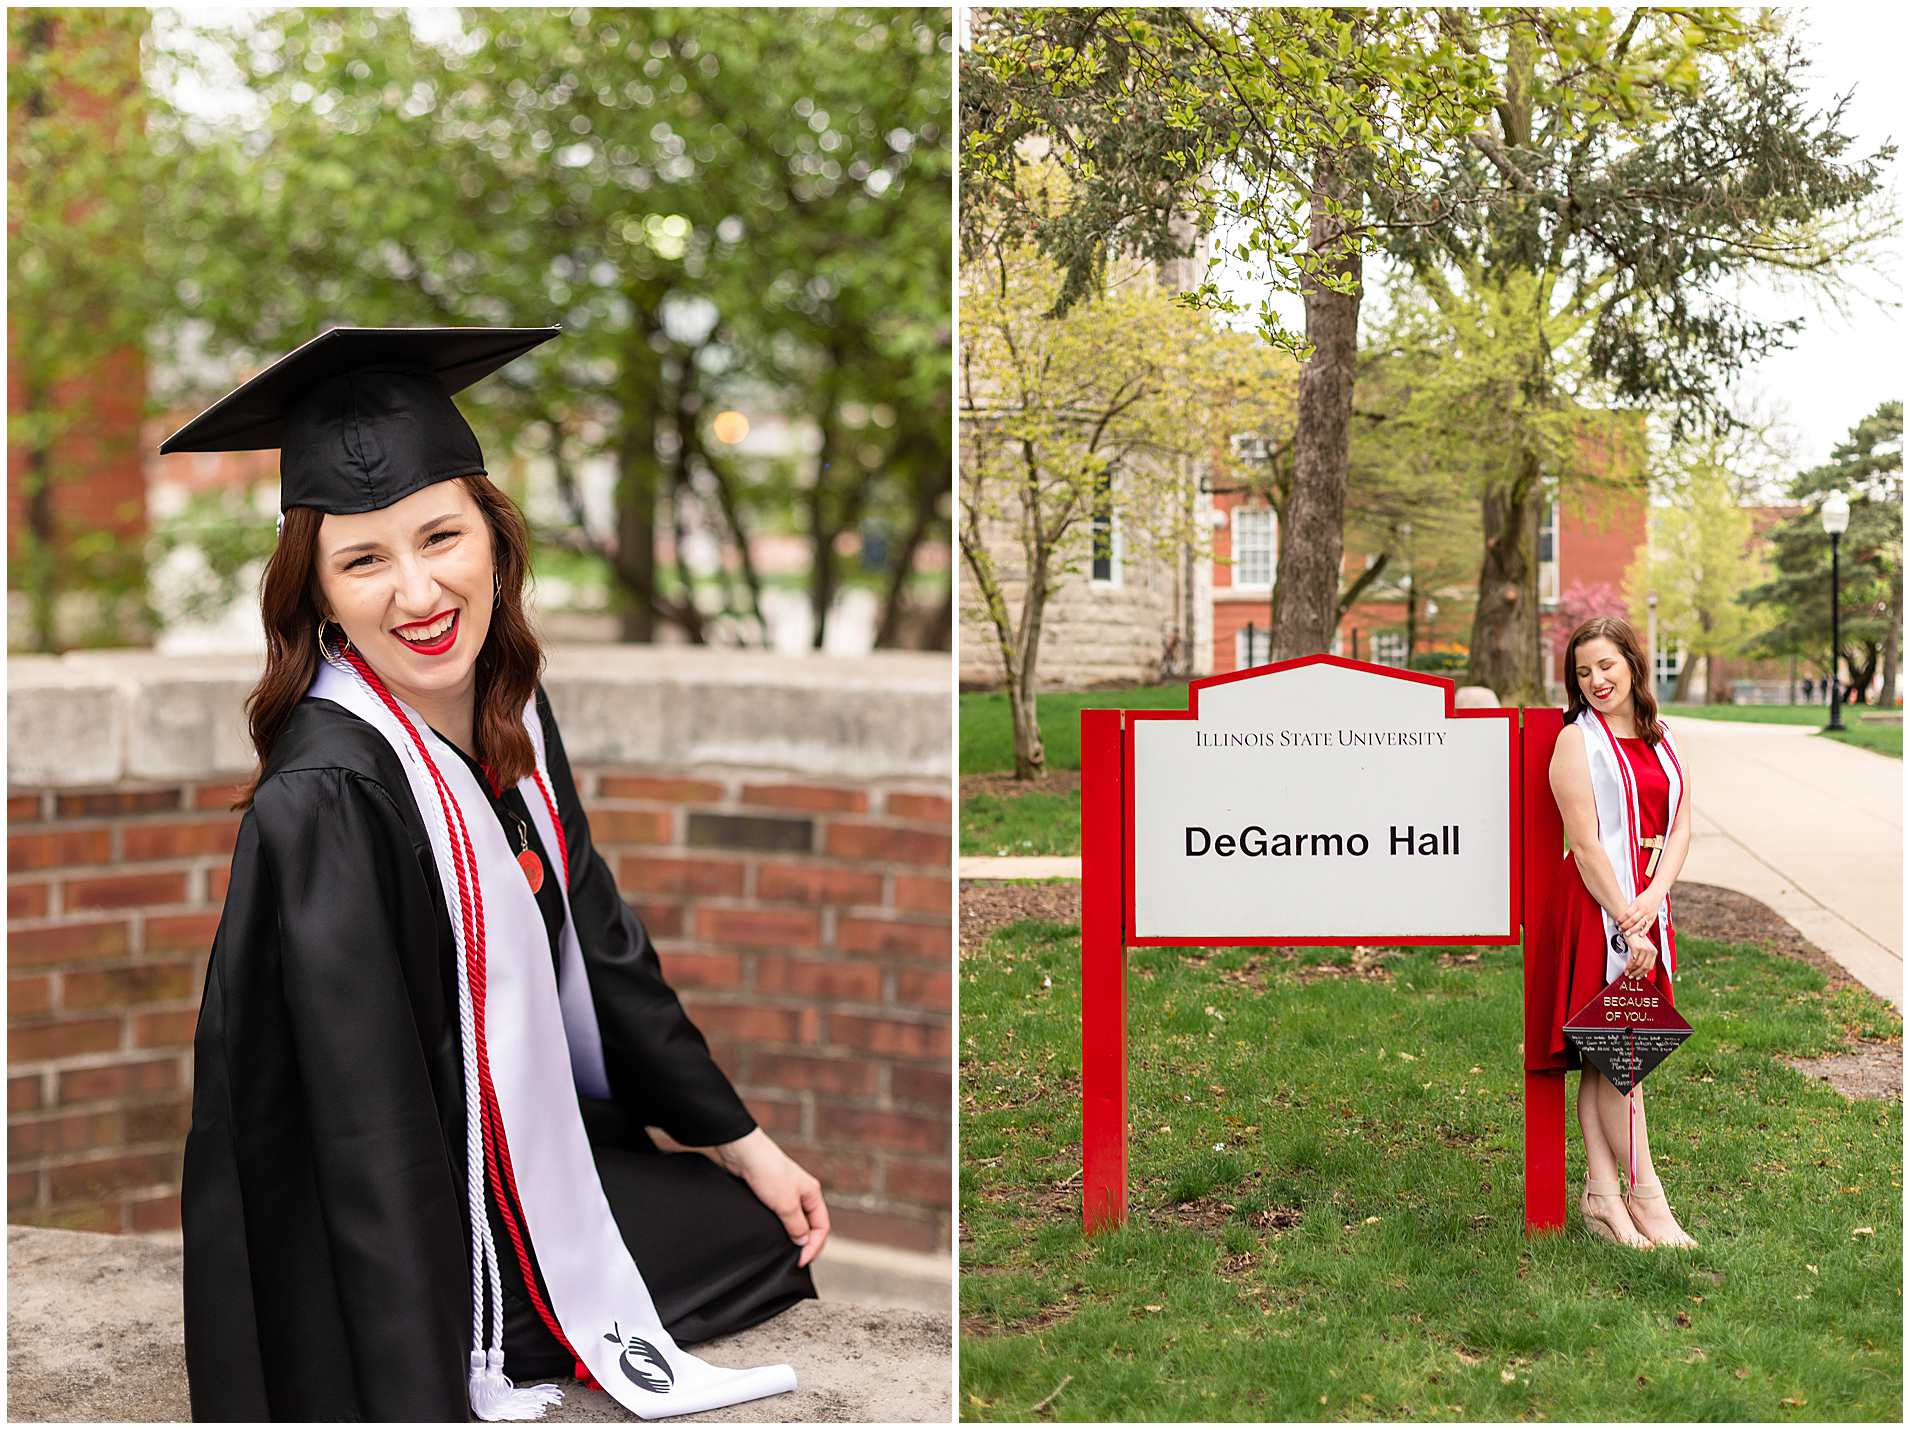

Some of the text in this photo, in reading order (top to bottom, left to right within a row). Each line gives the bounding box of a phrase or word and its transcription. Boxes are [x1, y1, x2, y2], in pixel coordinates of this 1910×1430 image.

[1195, 730, 1447, 747] ILLINOIS STATE UNIVERSITY
[1185, 825, 1460, 857] DeGarmo Hall
[1619, 981, 1644, 992] ALL
[1603, 996, 1659, 1008] BECAUSE
[1605, 1011, 1622, 1022] OF
